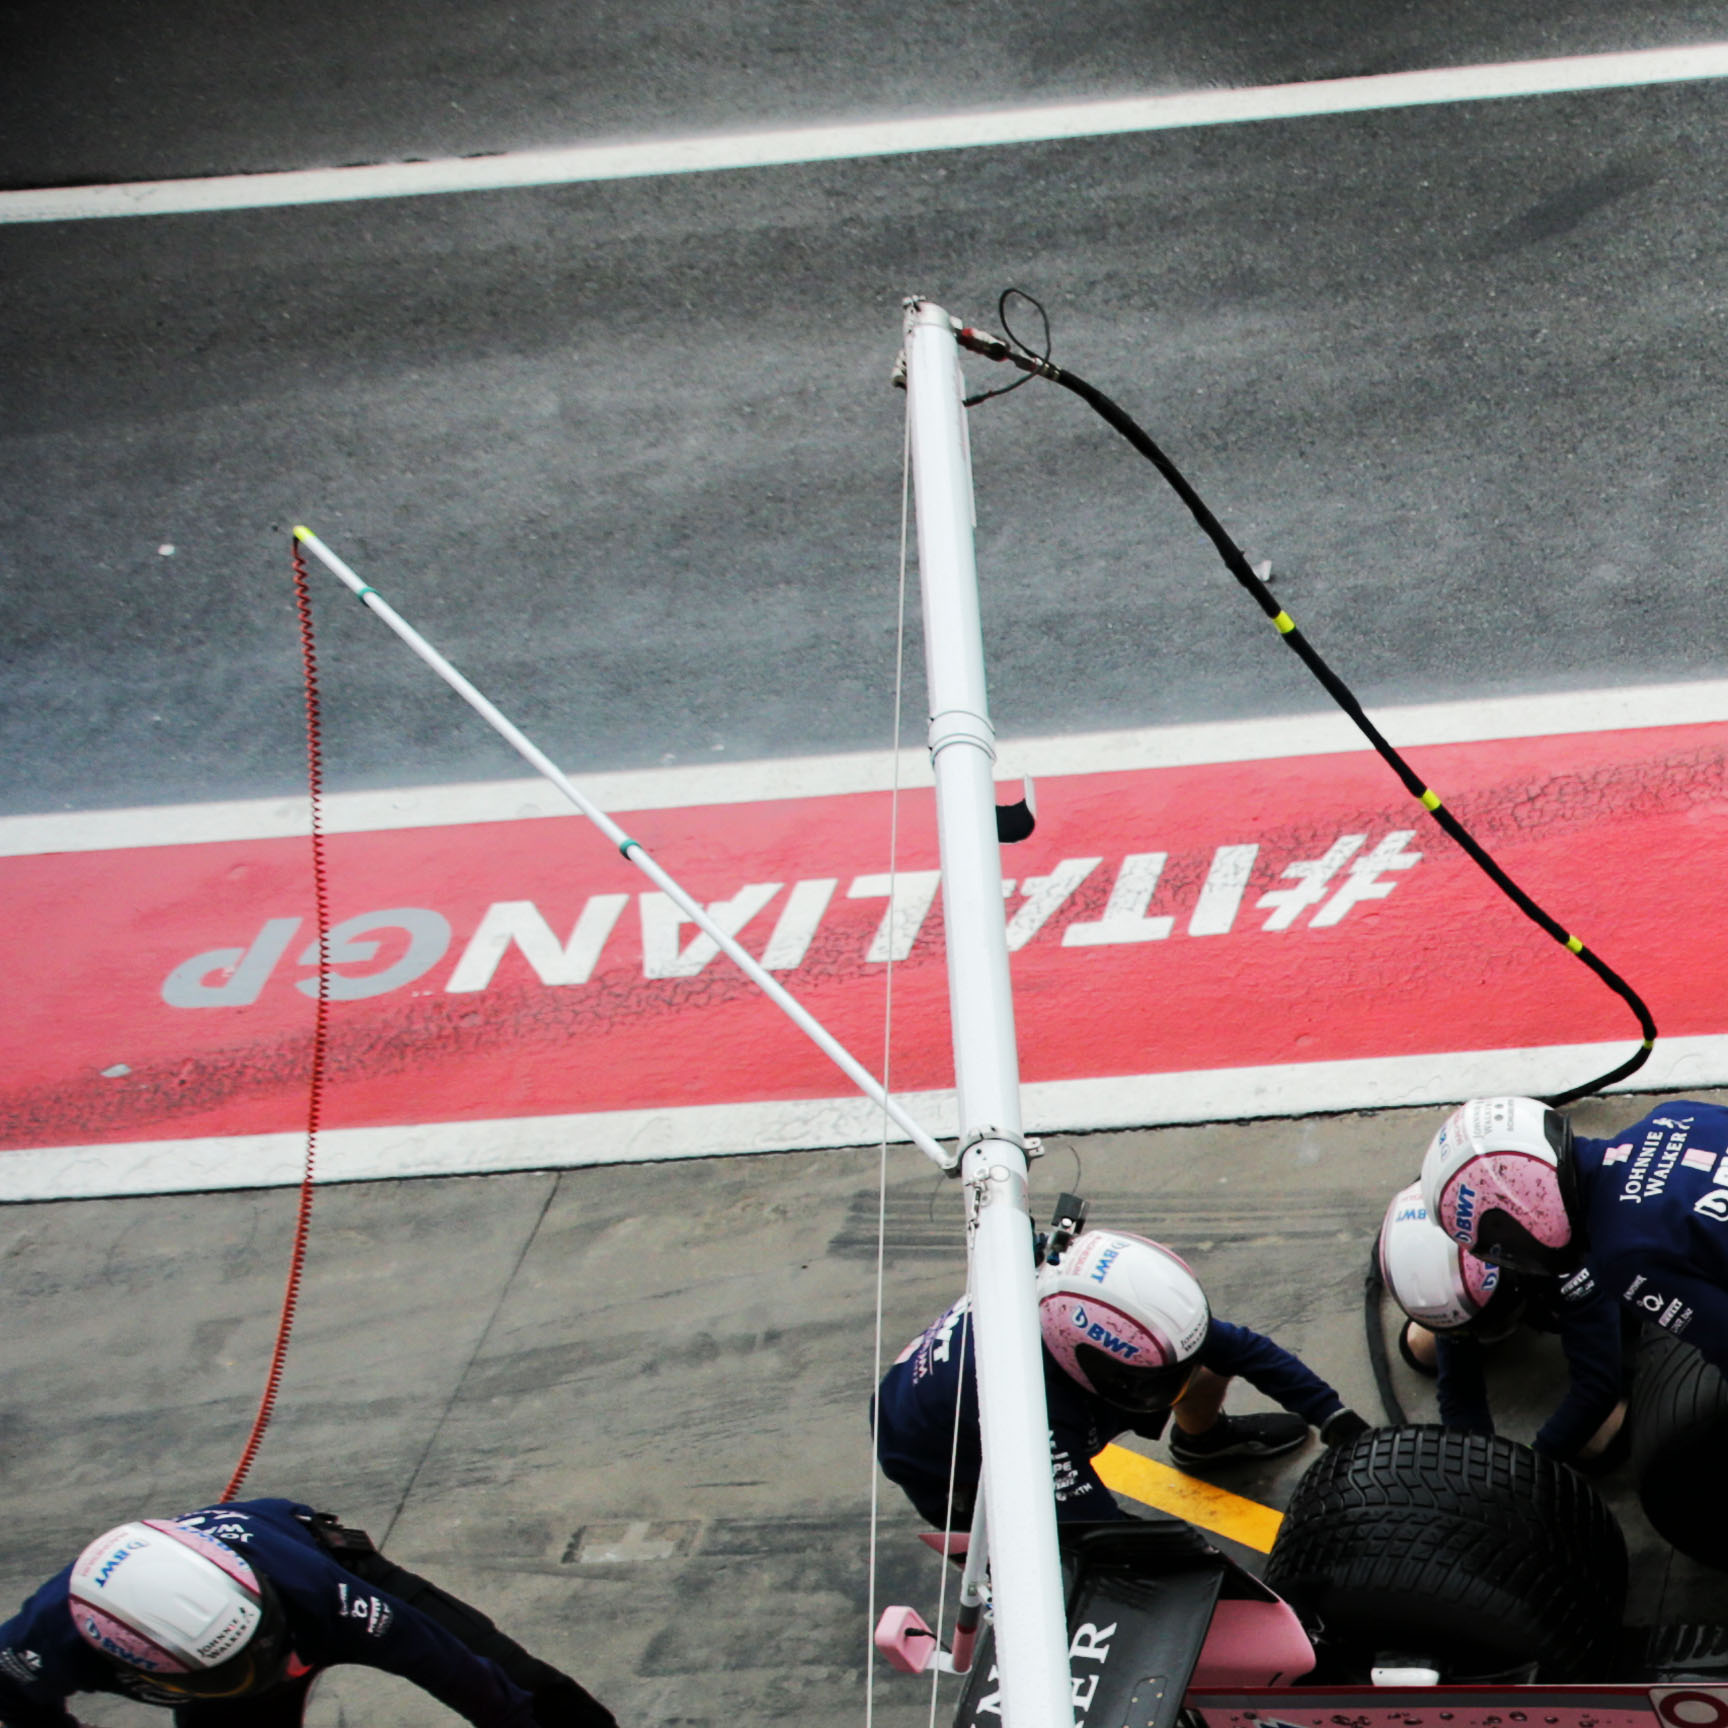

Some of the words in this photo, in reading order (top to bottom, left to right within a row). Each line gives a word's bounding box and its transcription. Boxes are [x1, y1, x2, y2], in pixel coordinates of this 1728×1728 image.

[1620, 1131, 1664, 1204] JOHNNIE
[1644, 1132, 1687, 1197] WALKER
[1456, 1183, 1476, 1231] BWT
[1090, 1249, 1119, 1284] BWT
[1087, 1322, 1139, 1361] BWT
[95, 1550, 130, 1588] BWT
[197, 1619, 240, 1658] JOHNNIE
